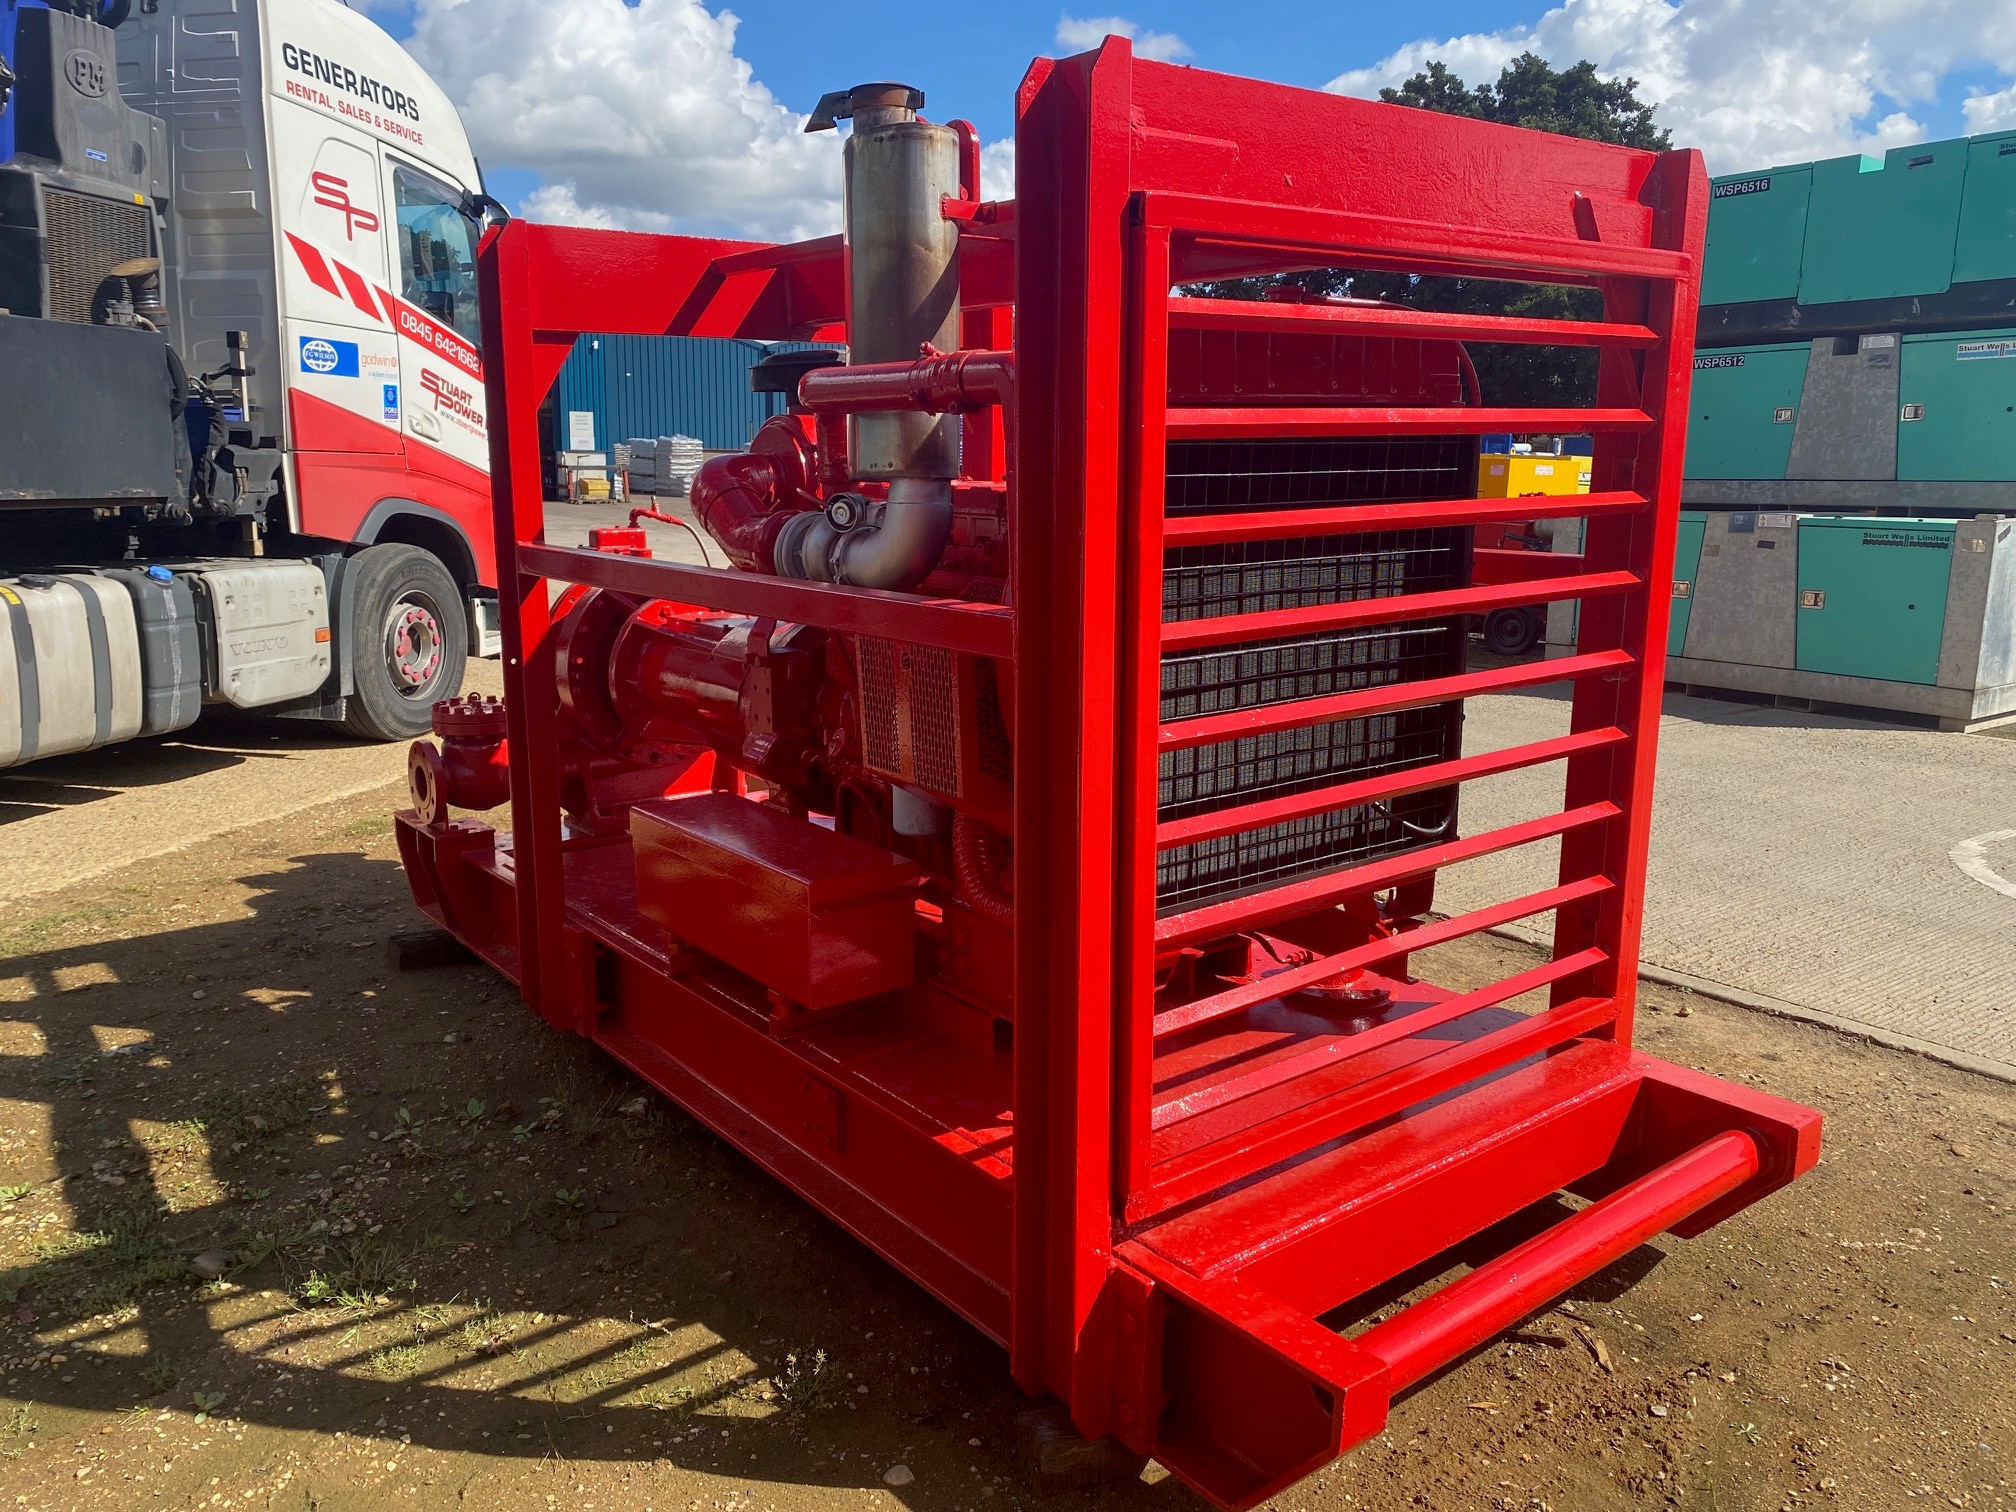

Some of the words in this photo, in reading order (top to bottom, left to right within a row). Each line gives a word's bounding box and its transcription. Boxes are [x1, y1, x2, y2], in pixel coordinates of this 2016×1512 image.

[282, 42, 420, 122] GENERATORS
[285, 79, 336, 113] RENTAL,
[338, 100, 372, 124] SALES
[374, 115, 382, 129] &
[383, 118, 424, 146] SERVICE
[1715, 179, 1768, 197] WSP6516
[311, 170, 379, 242] SP
[400, 310, 433, 343] 0845
[434, 331, 480, 373] 6421662
[1958, 344, 1985, 352] Stuart
[1986, 342, 2010, 357] Wells
[361, 353, 391, 368] godwin
[1694, 355, 1745, 369] WSP6512
[420, 367, 473, 407] STUART
[434, 393, 484, 428] POWER
[1891, 534, 1914, 547] Wells
[229, 636, 289, 656] VOLVO
